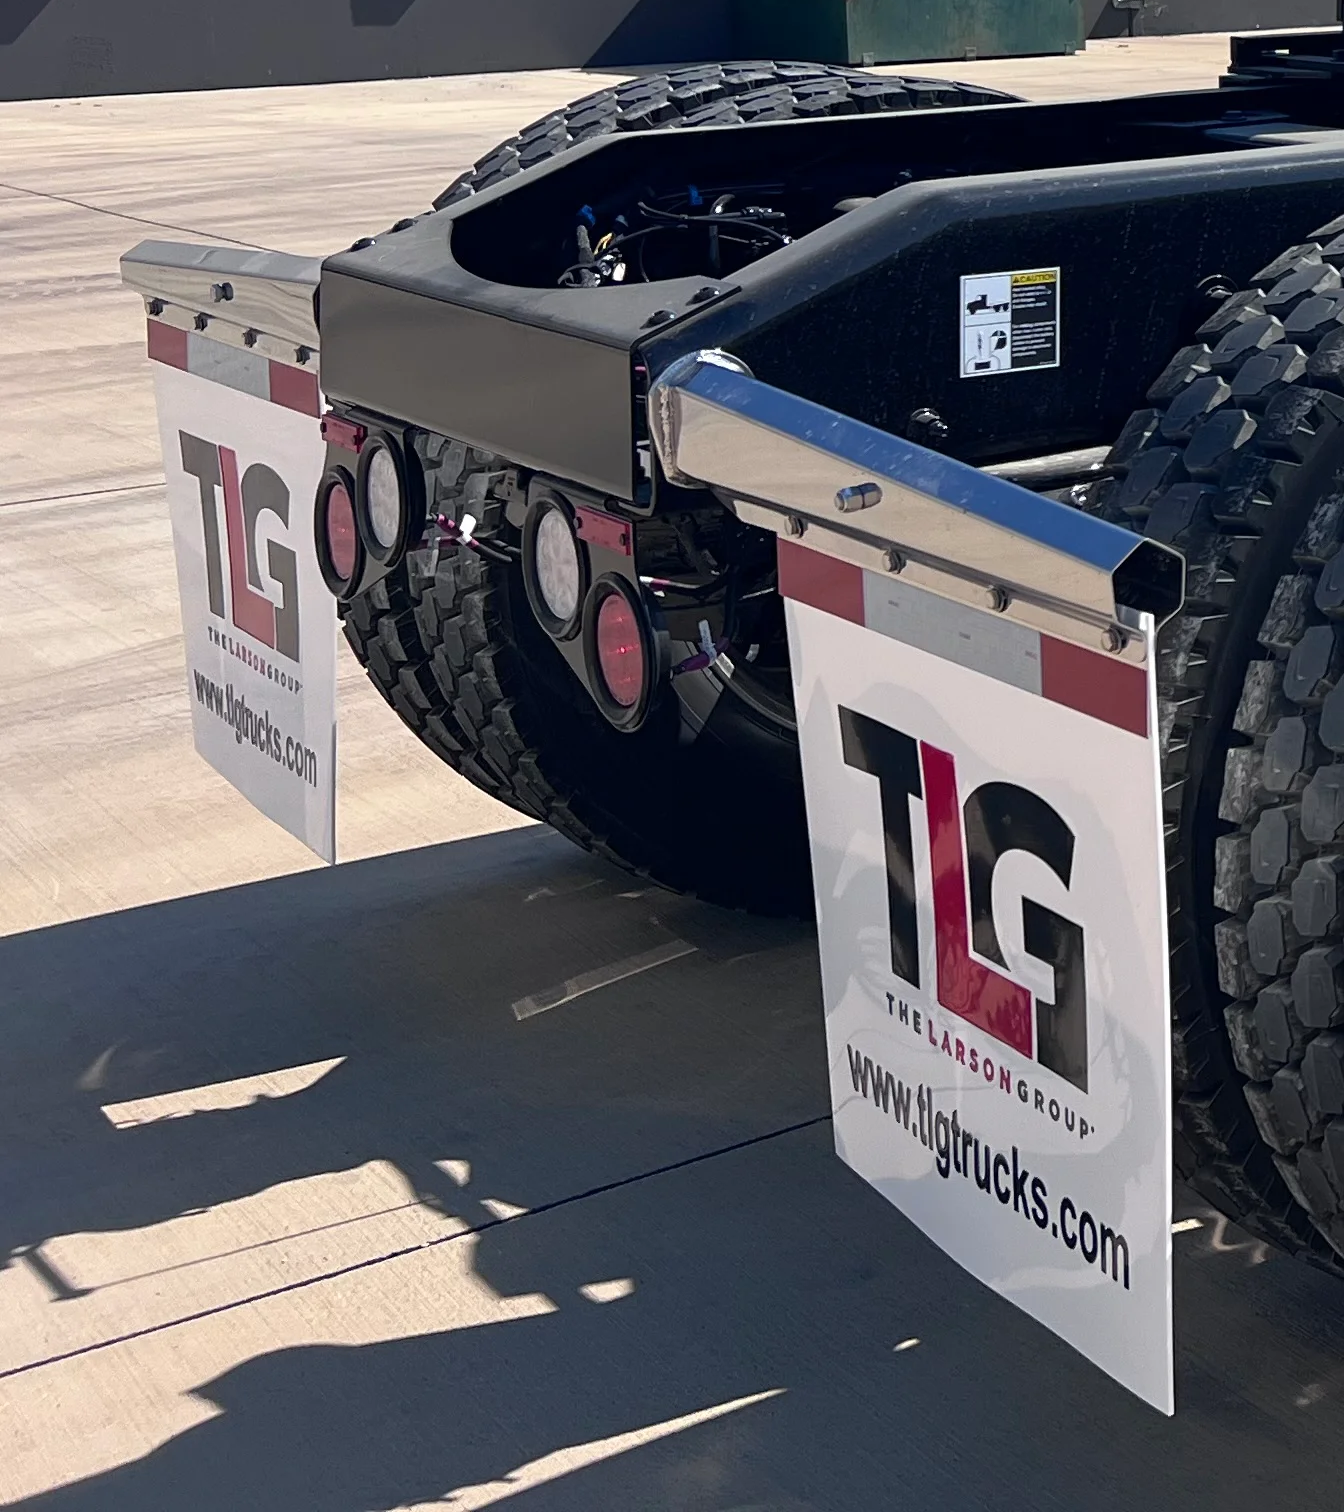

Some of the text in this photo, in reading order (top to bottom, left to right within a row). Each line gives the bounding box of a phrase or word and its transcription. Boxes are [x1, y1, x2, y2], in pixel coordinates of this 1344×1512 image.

[1020, 273, 1056, 284] CAUTION
[178, 429, 301, 663] TLG
[208, 626, 228, 651] THE
[194, 668, 318, 787] www.tlgtrucks.com
[838, 703, 1089, 1095] TLG
[885, 991, 1090, 1140] THE LARSON GROUP
[846, 1043, 1130, 1290] www.tlgtrucks.com
